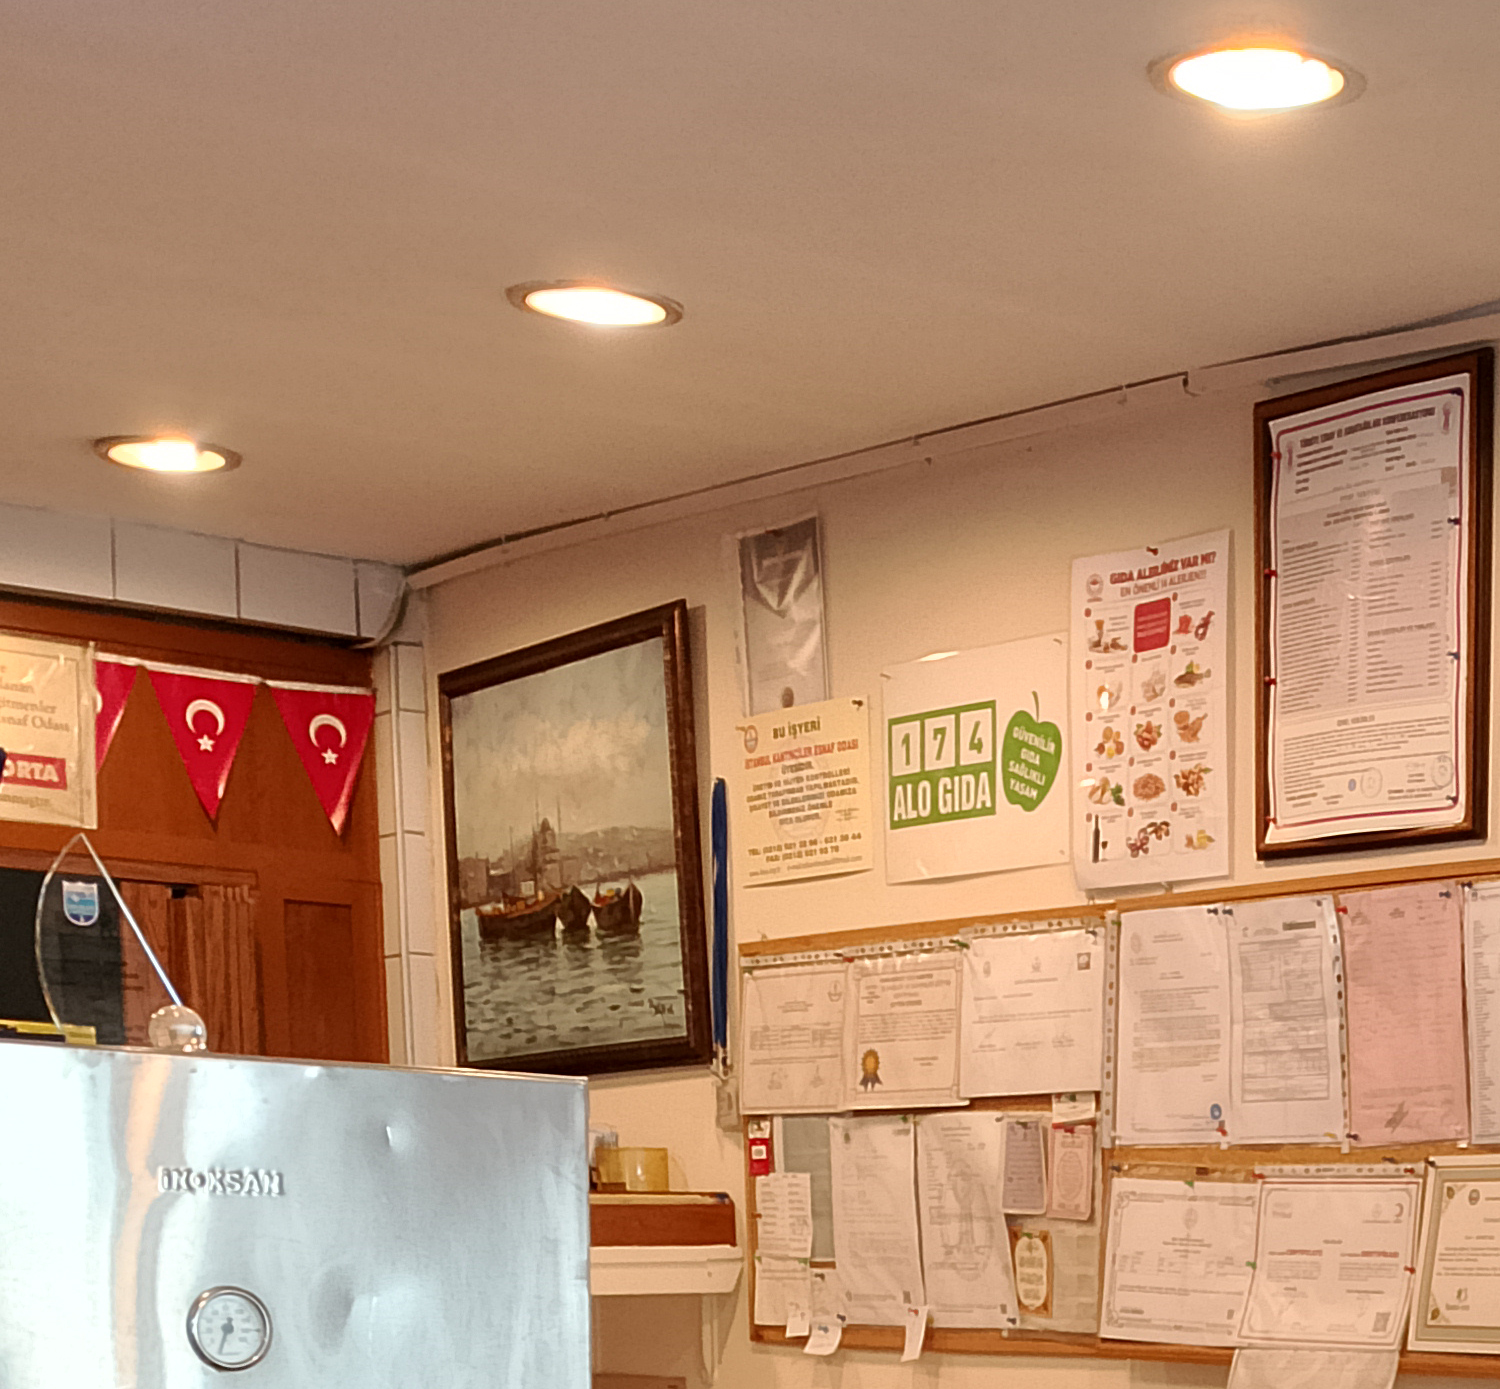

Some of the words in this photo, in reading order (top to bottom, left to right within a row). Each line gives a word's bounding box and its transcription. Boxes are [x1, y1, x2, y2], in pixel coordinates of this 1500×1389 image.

[772, 726, 786, 740] BU
[894, 780, 931, 821] ALO
[938, 772, 992, 815] GIDA
